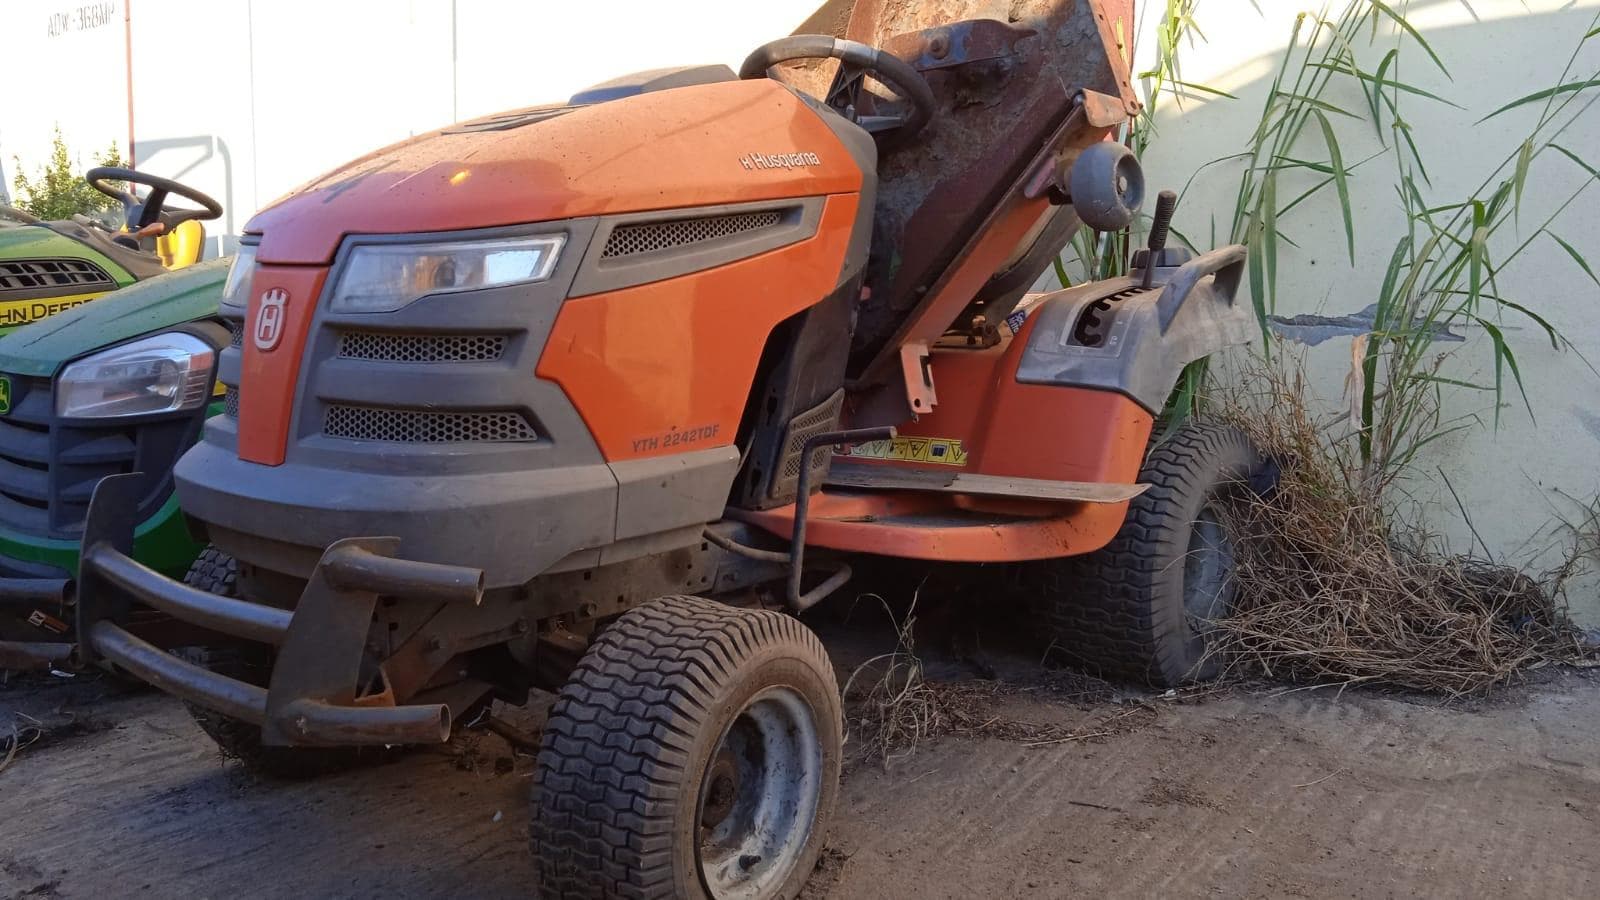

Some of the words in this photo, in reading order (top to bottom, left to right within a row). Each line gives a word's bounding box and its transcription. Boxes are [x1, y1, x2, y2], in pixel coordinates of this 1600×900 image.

[749, 151, 821, 171] Husqvarna
[632, 437, 659, 453] YTH
[663, 423, 720, 448] 2242TDF
